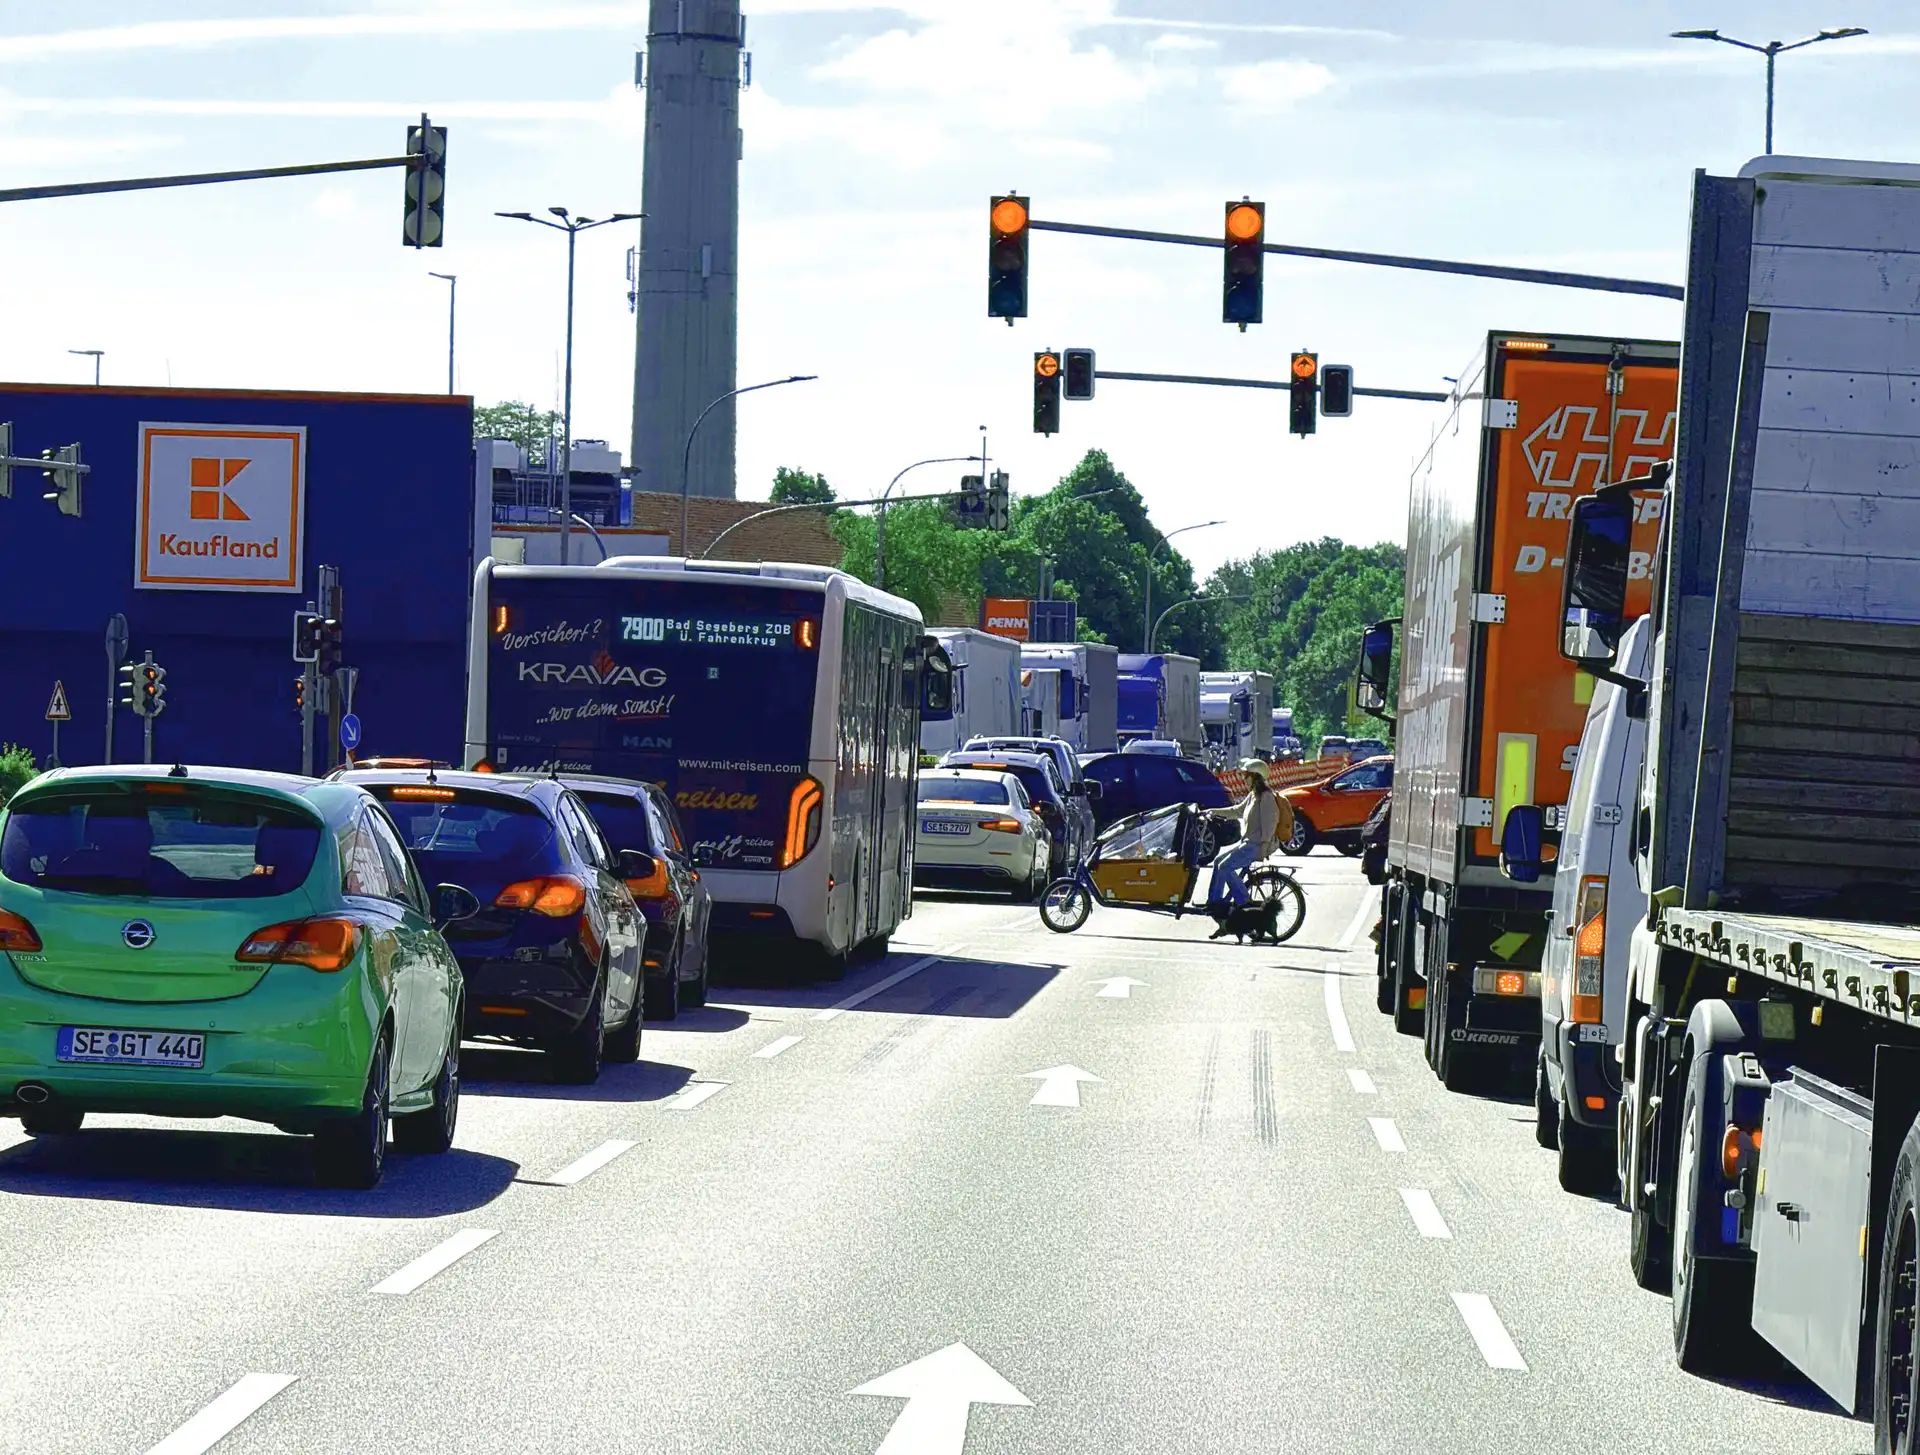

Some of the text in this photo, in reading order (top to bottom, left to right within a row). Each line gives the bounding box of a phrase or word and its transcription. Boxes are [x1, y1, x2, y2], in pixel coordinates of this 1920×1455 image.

[159, 533, 278, 559] Kaufland
[621, 616, 664, 641] 7900
[666, 618, 791, 635] Bad Segeberg ZOB
[698, 631, 776, 646] Fahrenkrug
[518, 661, 668, 687] KRAVAG
[576, 698, 618, 718] denn
[621, 694, 675, 715] sonst!
[622, 735, 673, 749] MAN
[563, 761, 592, 771] reisen
[678, 758, 801, 774] www.mit-reisen.com
[675, 786, 759, 810] reisen
[744, 837, 775, 848] reisen
[73, 1030, 202, 1060] SE GT 440
[1467, 1032, 1520, 1045] KRONE
